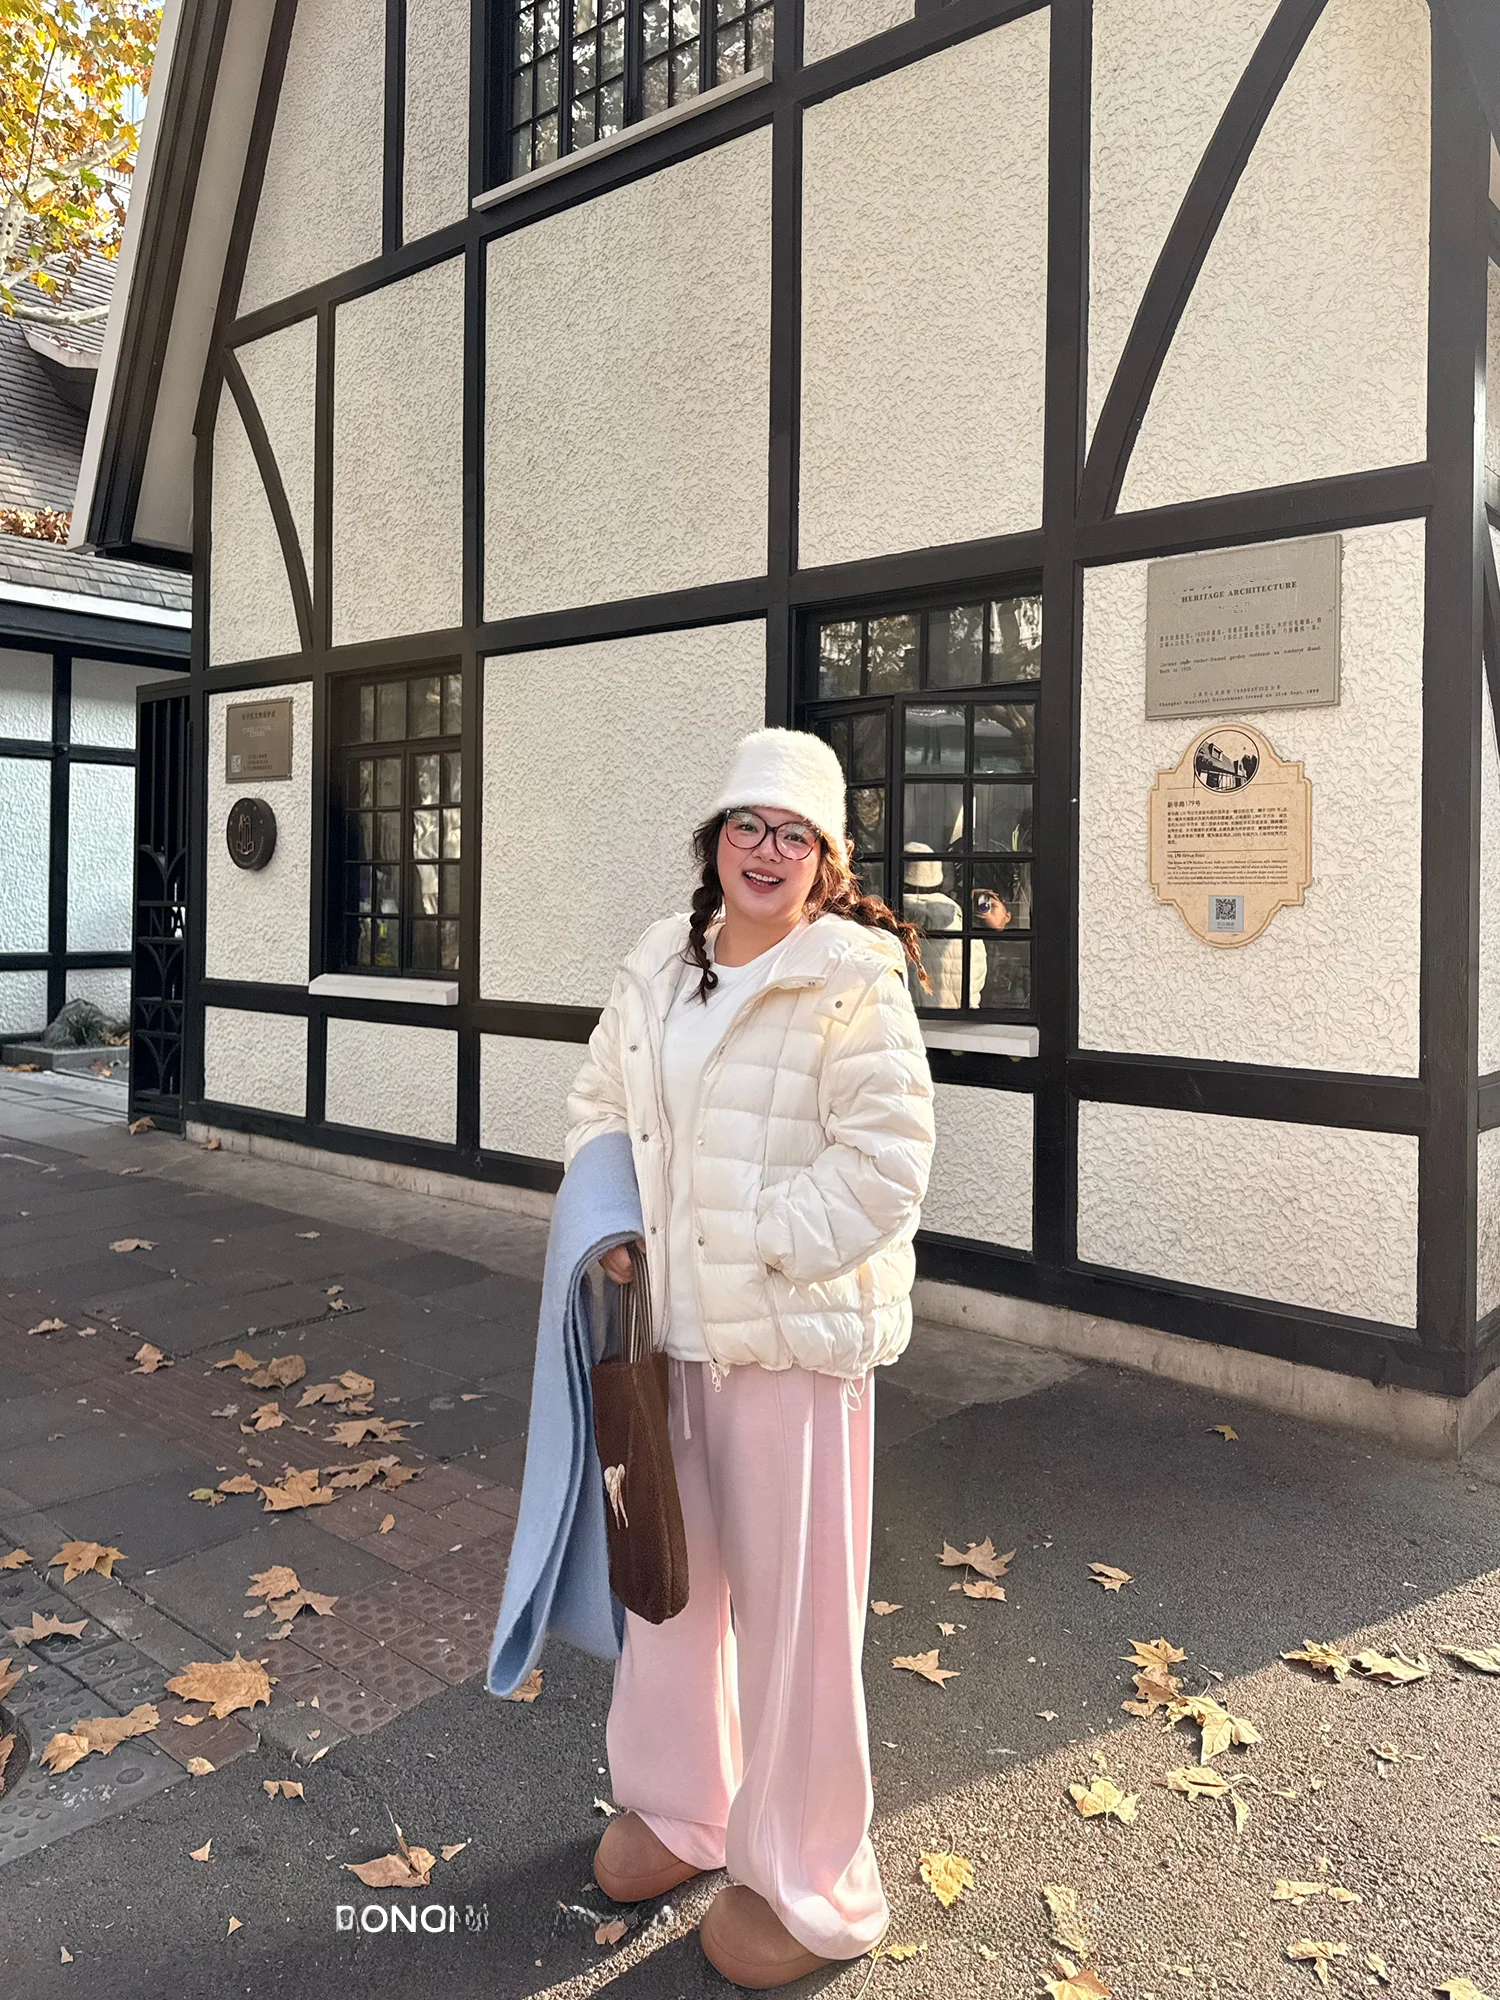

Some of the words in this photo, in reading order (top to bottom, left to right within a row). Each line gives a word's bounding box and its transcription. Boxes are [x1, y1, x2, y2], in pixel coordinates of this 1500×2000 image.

[1181, 590, 1225, 603] HERITAGE
[1227, 580, 1298, 597] ARCHITECTURE
[1212, 695, 1243, 703] Government
[1167, 800, 1201, 808] 新华路179号
